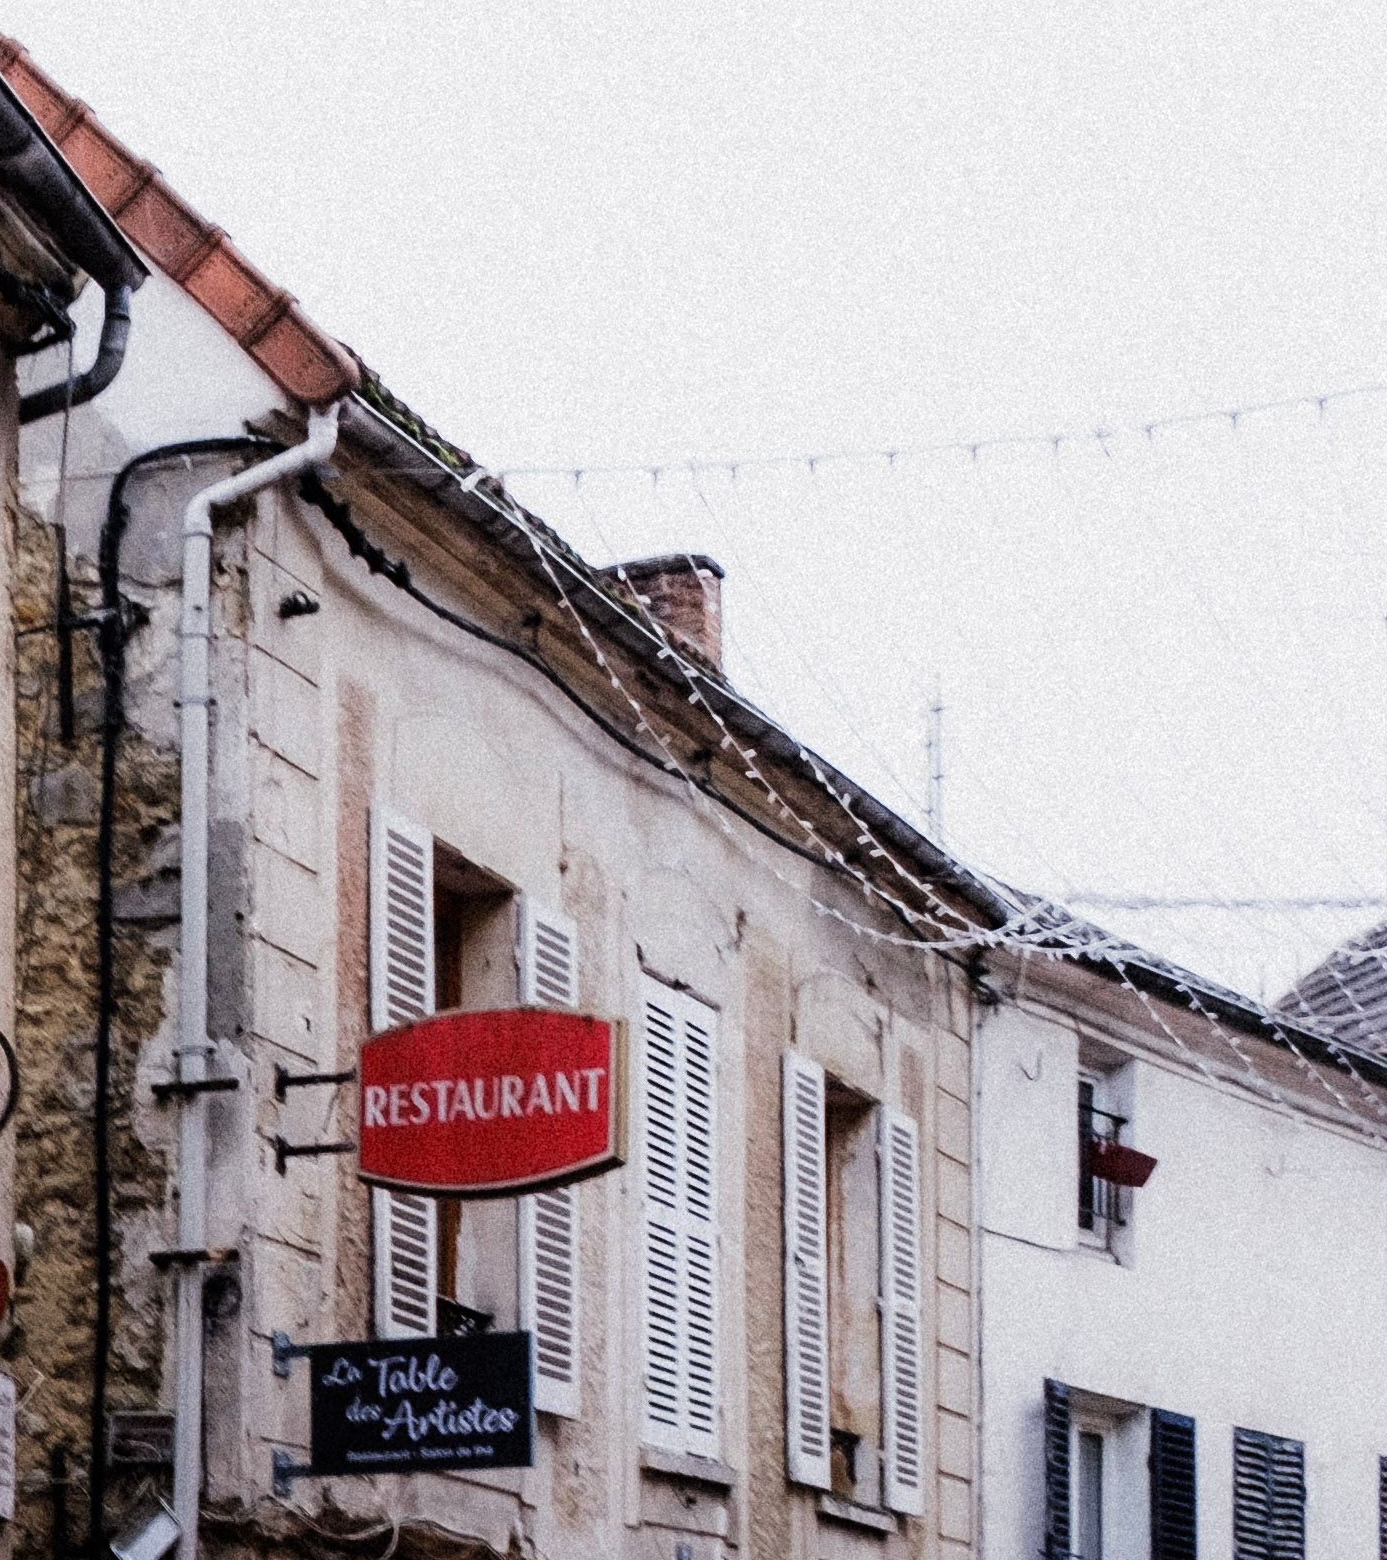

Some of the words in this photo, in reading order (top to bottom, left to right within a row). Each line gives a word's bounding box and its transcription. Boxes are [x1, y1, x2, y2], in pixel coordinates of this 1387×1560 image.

[364, 1067, 606, 1128] RESTAURANT
[322, 1357, 363, 1386] La
[367, 1353, 459, 1398] Table
[346, 1396, 381, 1423] des
[381, 1397, 520, 1441] Artistes
